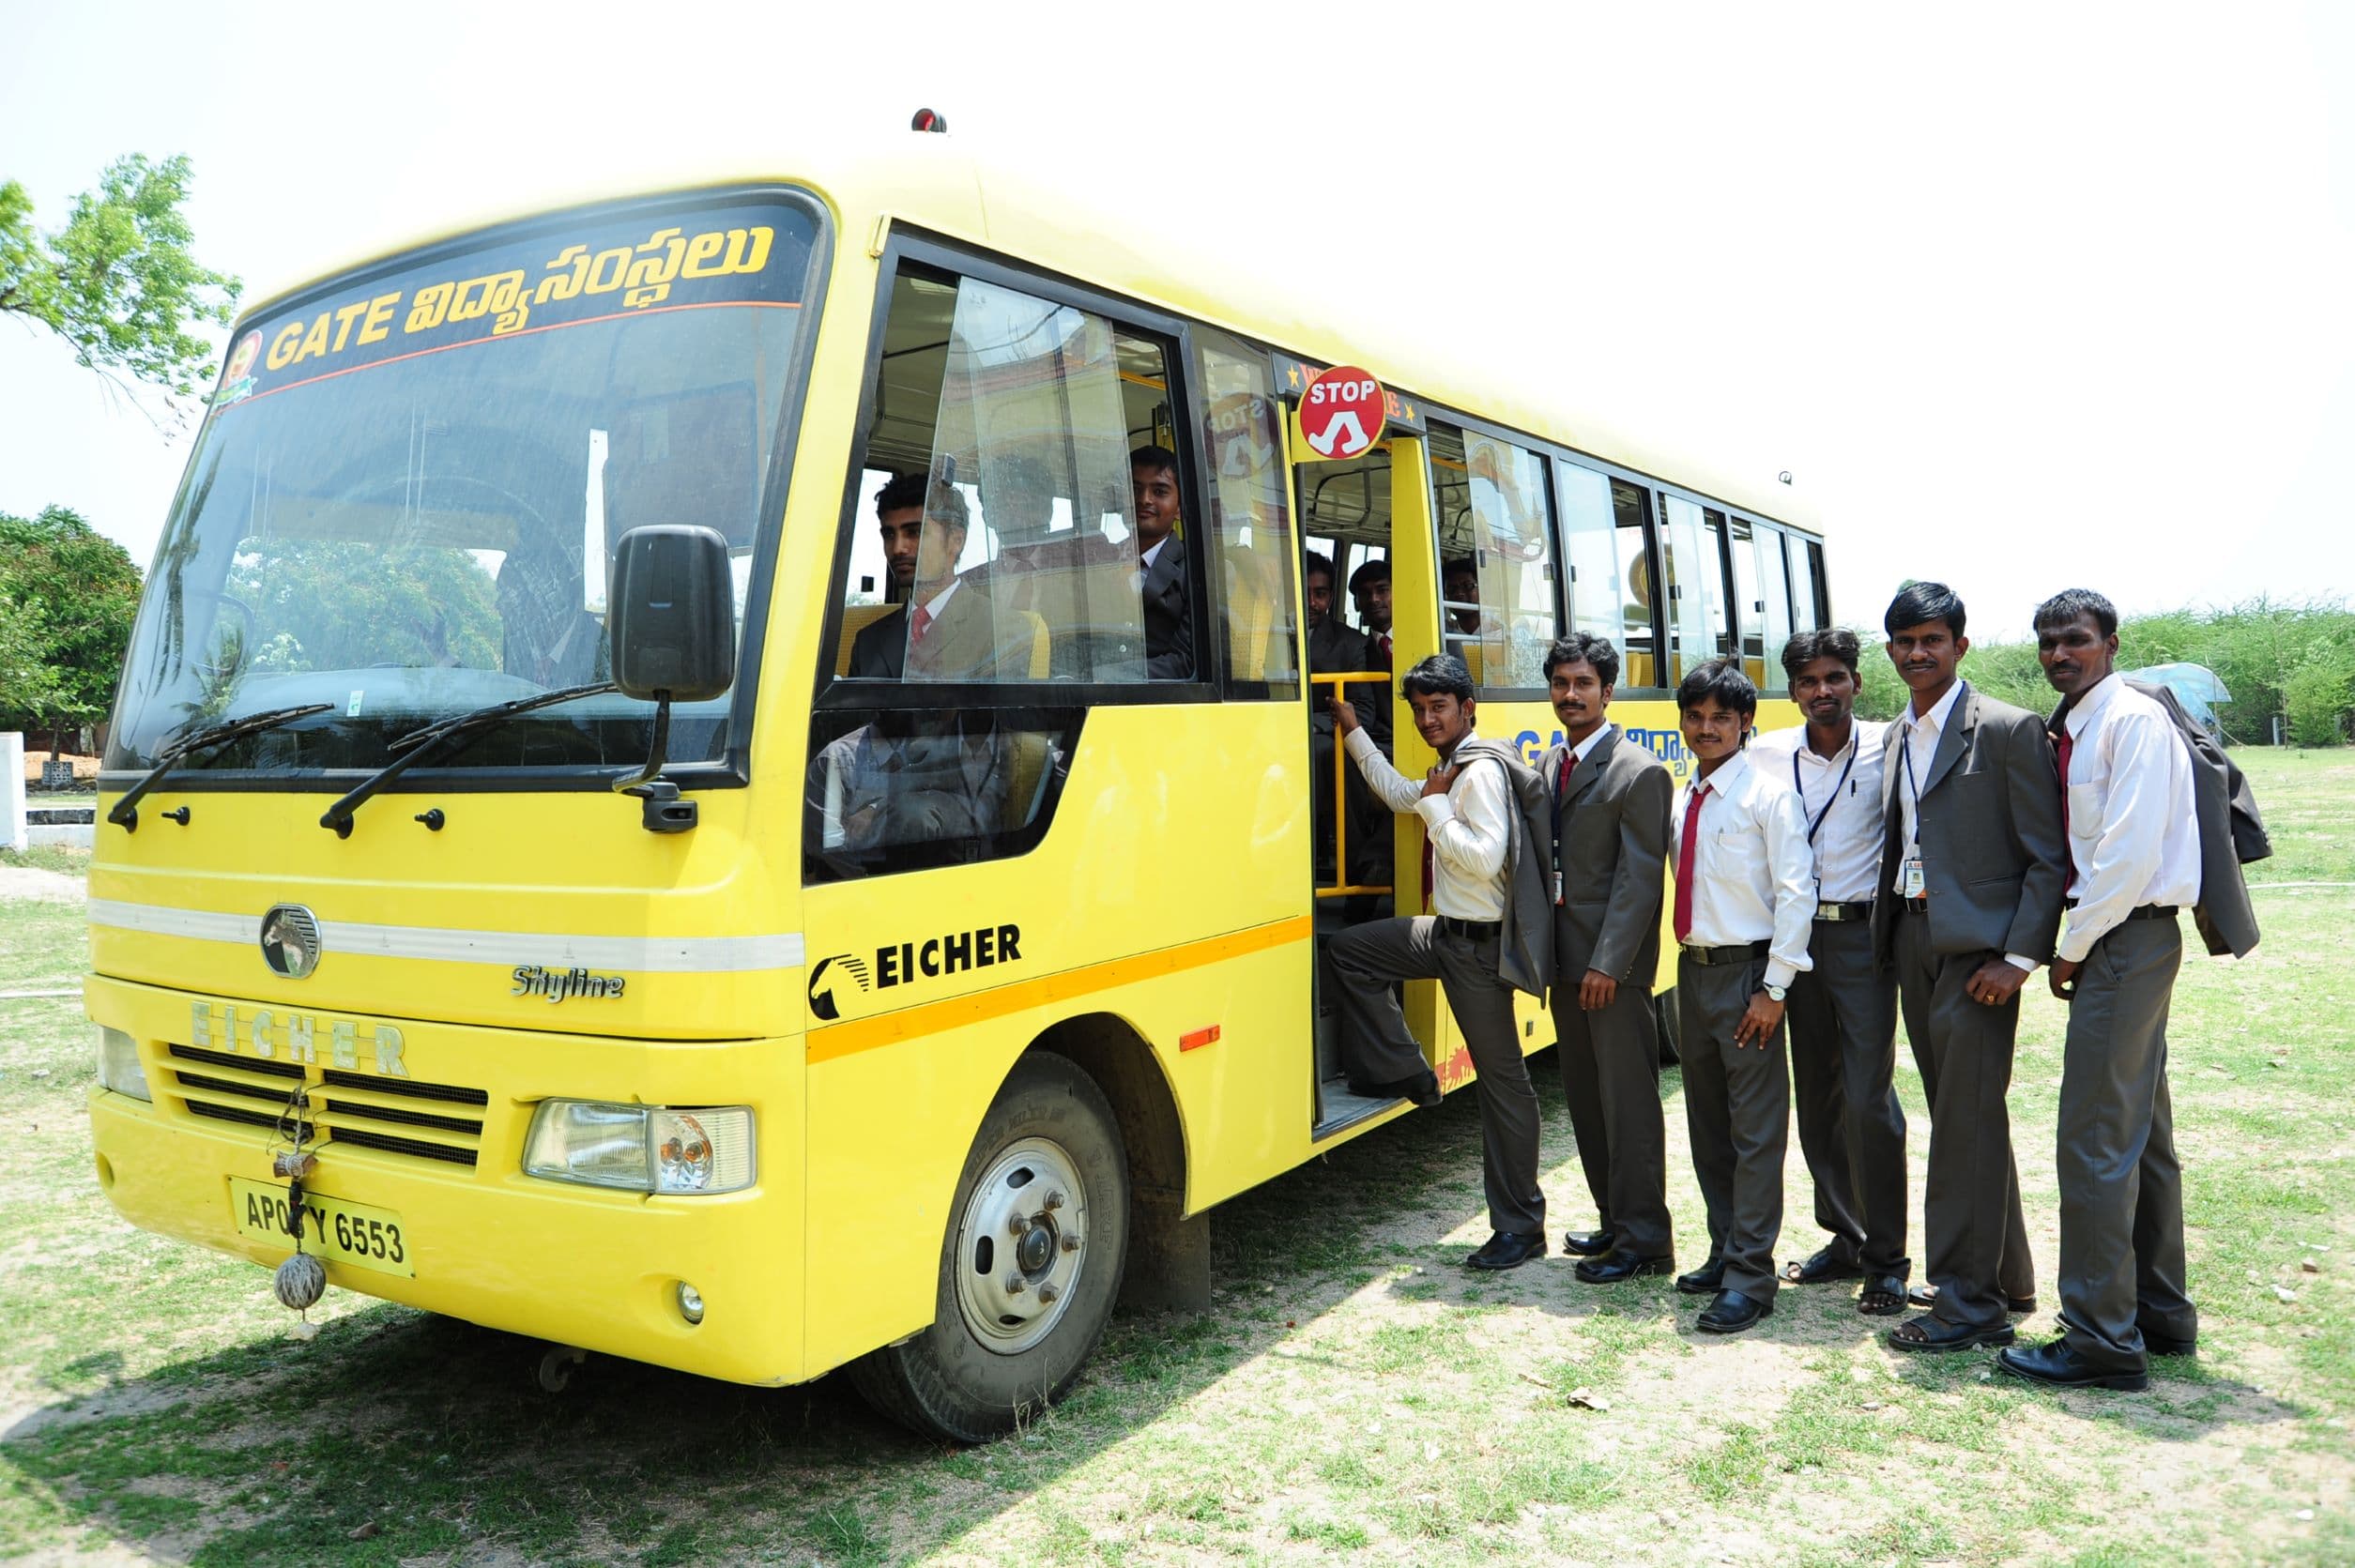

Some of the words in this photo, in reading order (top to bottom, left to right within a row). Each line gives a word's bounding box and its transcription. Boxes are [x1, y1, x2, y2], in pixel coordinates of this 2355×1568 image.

[267, 292, 401, 370] GATE
[1309, 380, 1375, 404] STOP
[511, 965, 625, 1004] Skyline
[877, 923, 1022, 989] EICHER
[191, 1000, 409, 1078] EICHER
[335, 1212, 405, 1264] 6553
